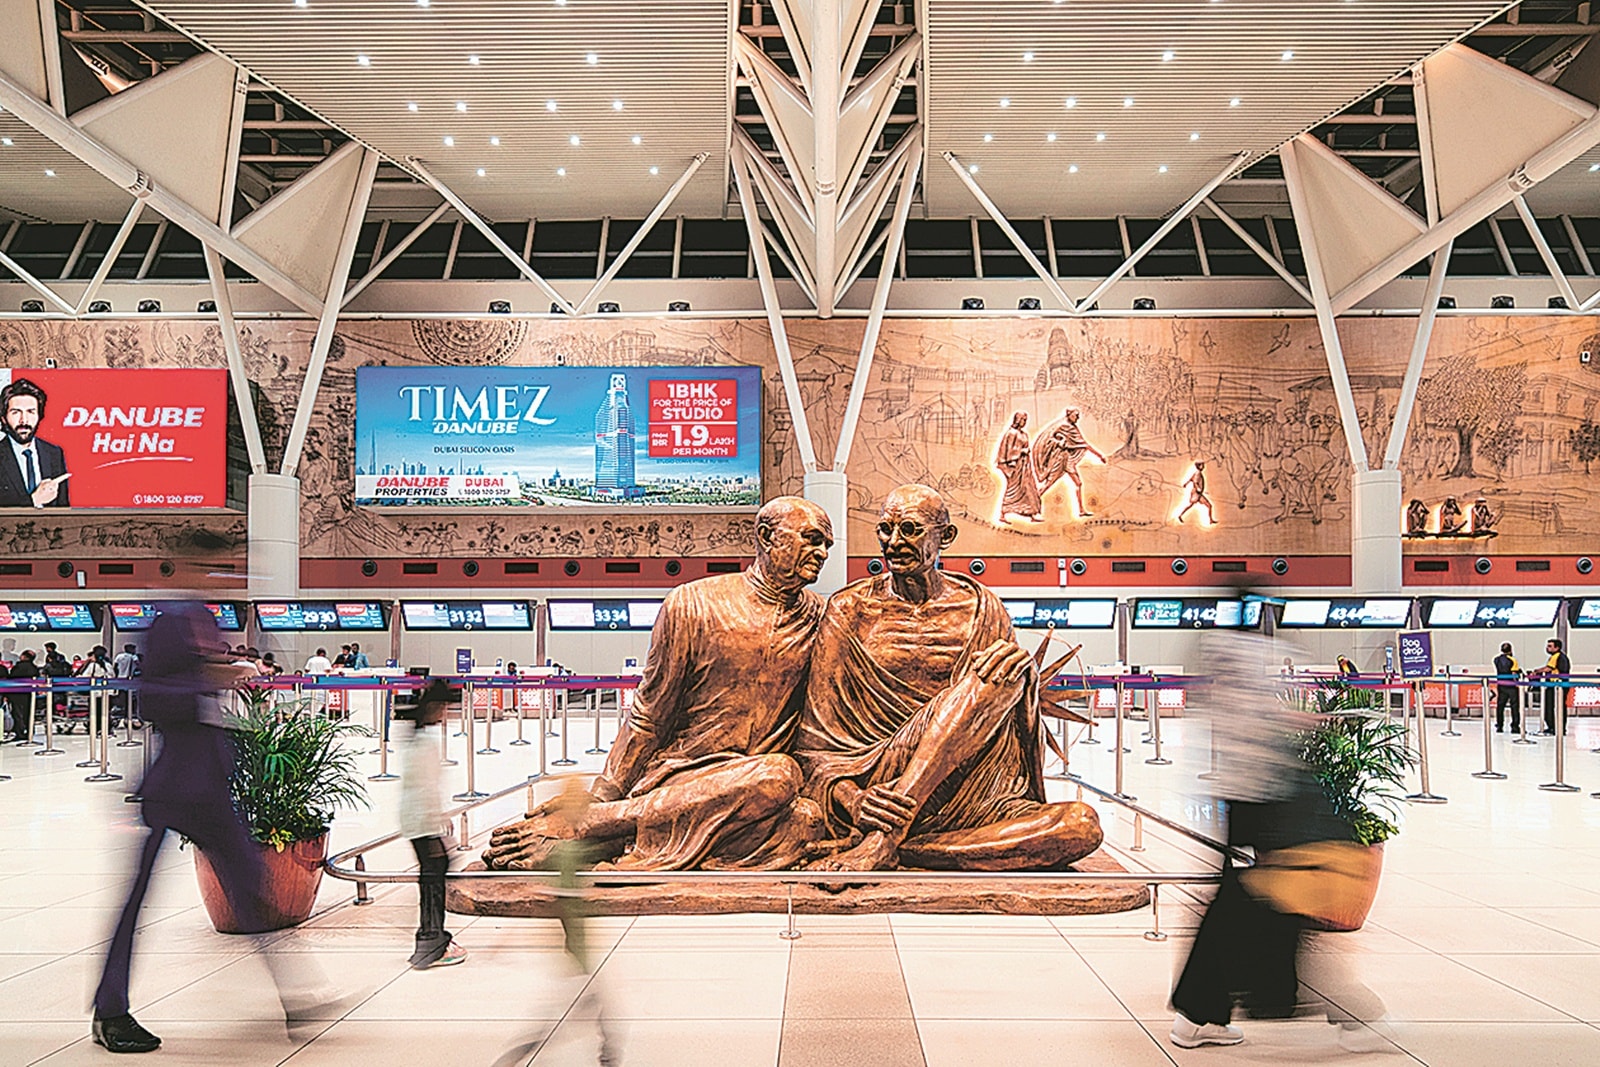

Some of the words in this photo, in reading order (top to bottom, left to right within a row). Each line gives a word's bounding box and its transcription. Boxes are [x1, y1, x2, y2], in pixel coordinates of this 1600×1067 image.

[667, 383, 718, 398] 1BHK
[399, 384, 557, 426] TIMEZ
[653, 399, 672, 407] FOR
[673, 398, 690, 406] THE
[693, 398, 718, 406] PRICE
[720, 398, 733, 406] OF
[63, 407, 205, 427] DANUBE
[662, 407, 723, 420] STUDIO
[433, 421, 520, 434] DANUBE
[671, 424, 710, 447] 1.9
[709, 438, 735, 446] LAKH
[92, 432, 135, 453] Hai
[138, 432, 174, 453] Na
[433, 446, 458, 454] DUBAI
[459, 446, 491, 454] SILICON
[492, 446, 515, 454] OASIS
[673, 448, 691, 456] PER
[693, 447, 729, 456] MONTH
[376, 477, 450, 487] DANUBE
[465, 478, 504, 487] DUBAI
[375, 488, 448, 497] PROPERTIES
[143, 495, 165, 504] 1800
[166, 495, 182, 504] 120
[184, 495, 204, 504] 5757
[27, 612, 47, 624] 26
[302, 611, 320, 623] 29
[319, 611, 337, 623] 30
[450, 610, 466, 623] 31
[465, 610, 483, 623] 32
[595, 609, 611, 621] 33
[611, 609, 628, 621] 34
[1034, 609, 1052, 620] 39
[1051, 609, 1068, 620] 40
[1181, 608, 1200, 620] 41
[1402, 646, 1424, 656] drop
